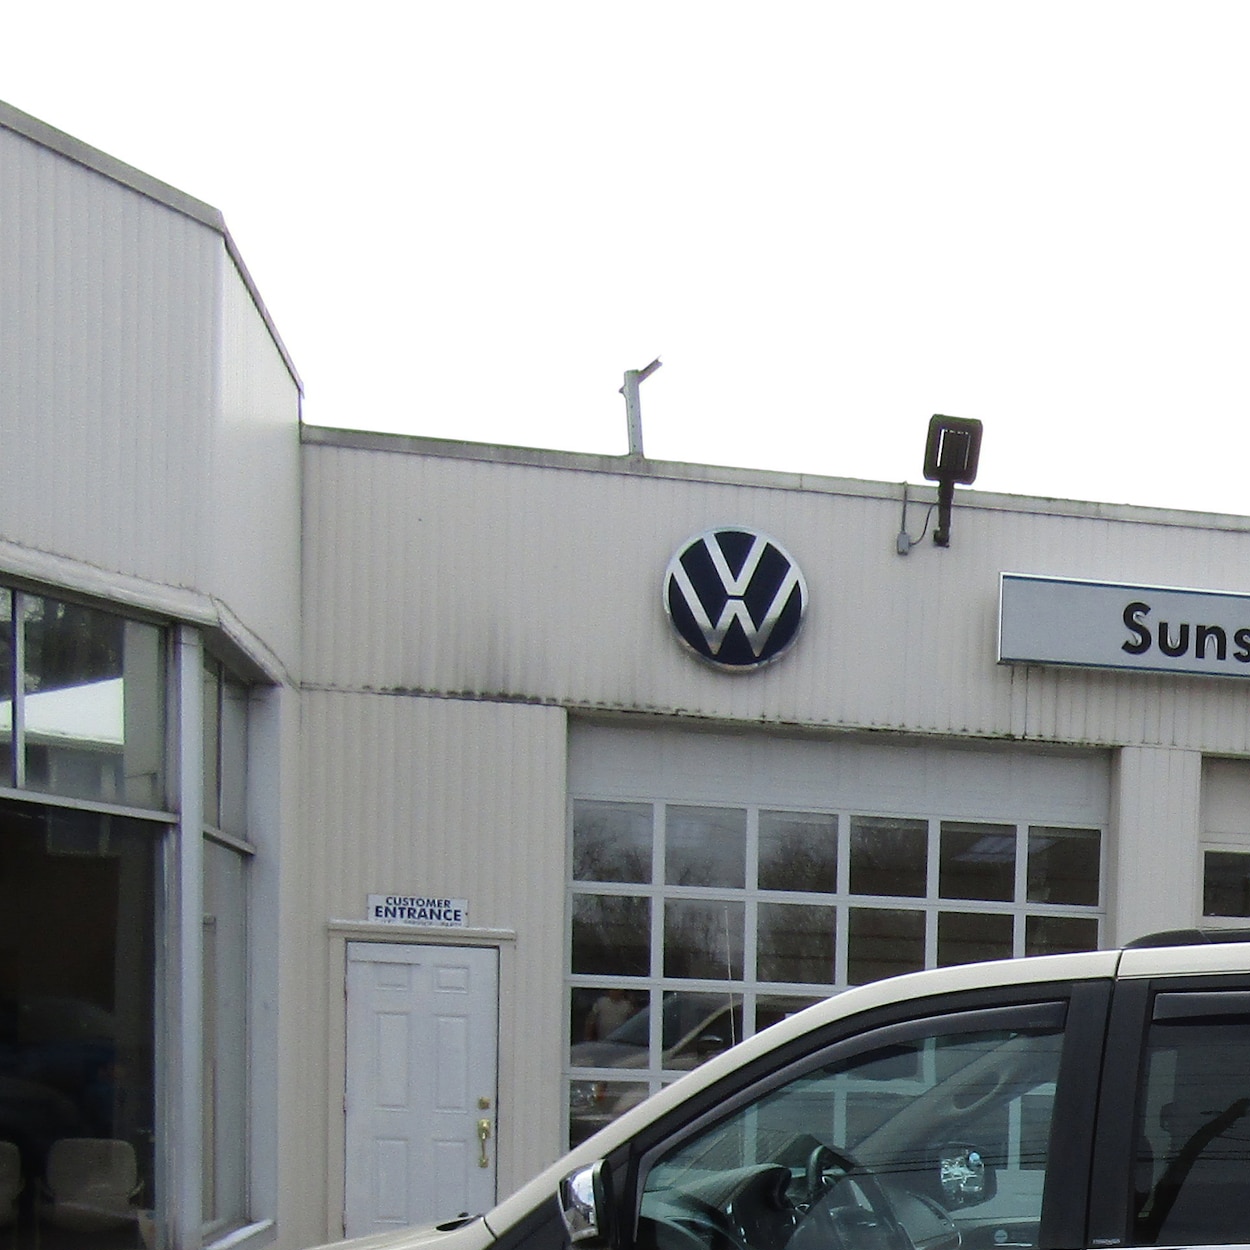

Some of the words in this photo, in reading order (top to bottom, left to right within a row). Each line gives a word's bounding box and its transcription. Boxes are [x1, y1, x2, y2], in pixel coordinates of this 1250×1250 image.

[664, 528, 807, 662] VW
[385, 896, 451, 909] CUSTOMER
[374, 905, 462, 922] ENTRANCE
